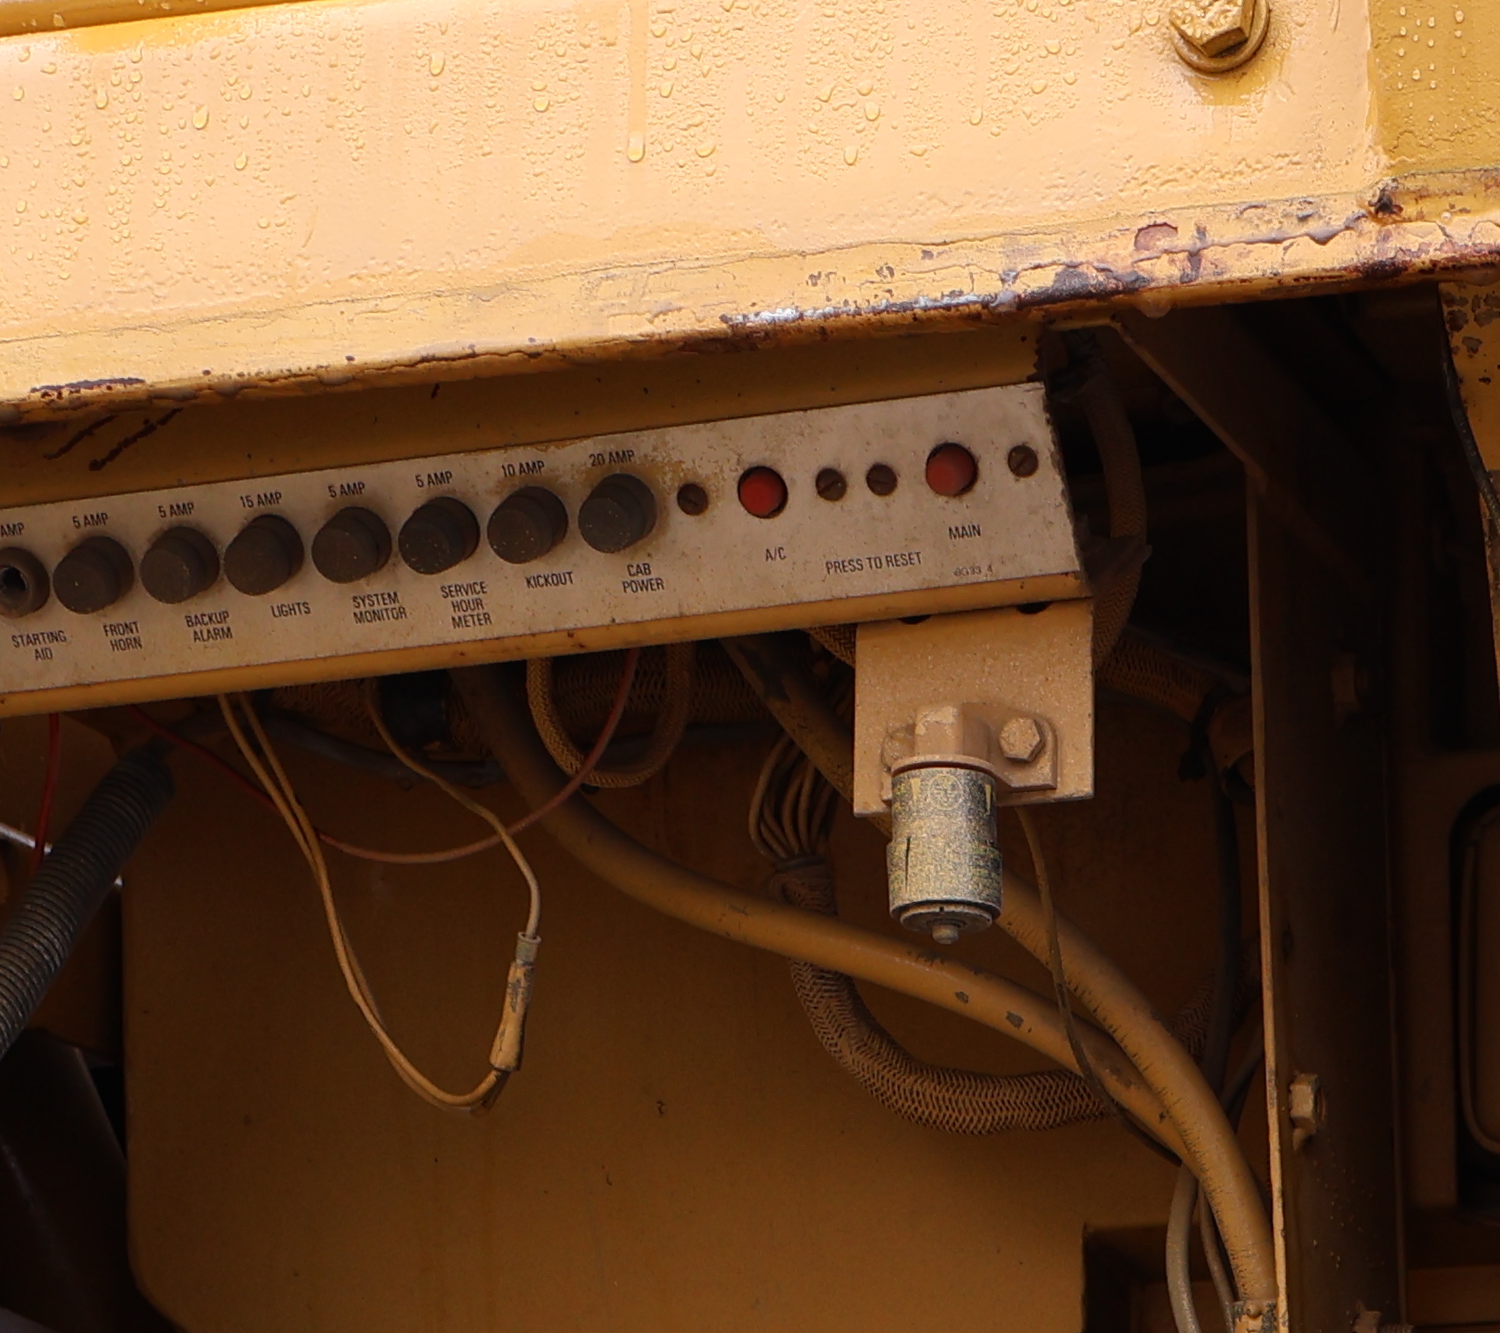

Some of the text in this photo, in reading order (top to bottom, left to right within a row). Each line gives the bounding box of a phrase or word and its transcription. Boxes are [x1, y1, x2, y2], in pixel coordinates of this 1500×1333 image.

[588, 449, 635, 467] 20 AMP
[501, 460, 546, 478] 10 AMP
[414, 470, 454, 488] 5 AMP
[328, 481, 366, 498] 5 AMP
[240, 491, 283, 508] 15 AMP
[158, 502, 195, 519] 5 AMP
[72, 512, 110, 529] 5 AMP
[0, 522, 25, 538] AMP
[948, 524, 982, 541] MAIN
[765, 546, 787, 562] A/C
[627, 562, 652, 577] CAB
[825, 551, 923, 575] PRESS TO RESET
[524, 571, 574, 589] KICKOUT
[622, 578, 665, 594] POWER
[440, 581, 487, 599] SERVICE
[352, 591, 400, 609] SYSTEM
[451, 597, 484, 613] HOUR
[270, 601, 311, 618] LIGHTS
[353, 606, 408, 625] MONITOR
[184, 610, 231, 629] BACKUP
[451, 612, 492, 630] METER
[102, 620, 140, 638] FRONT
[192, 626, 234, 644] ALARM
[10, 629, 67, 648] STARTING
[110, 636, 143, 653] HORN
[33, 646, 54, 662] AID
